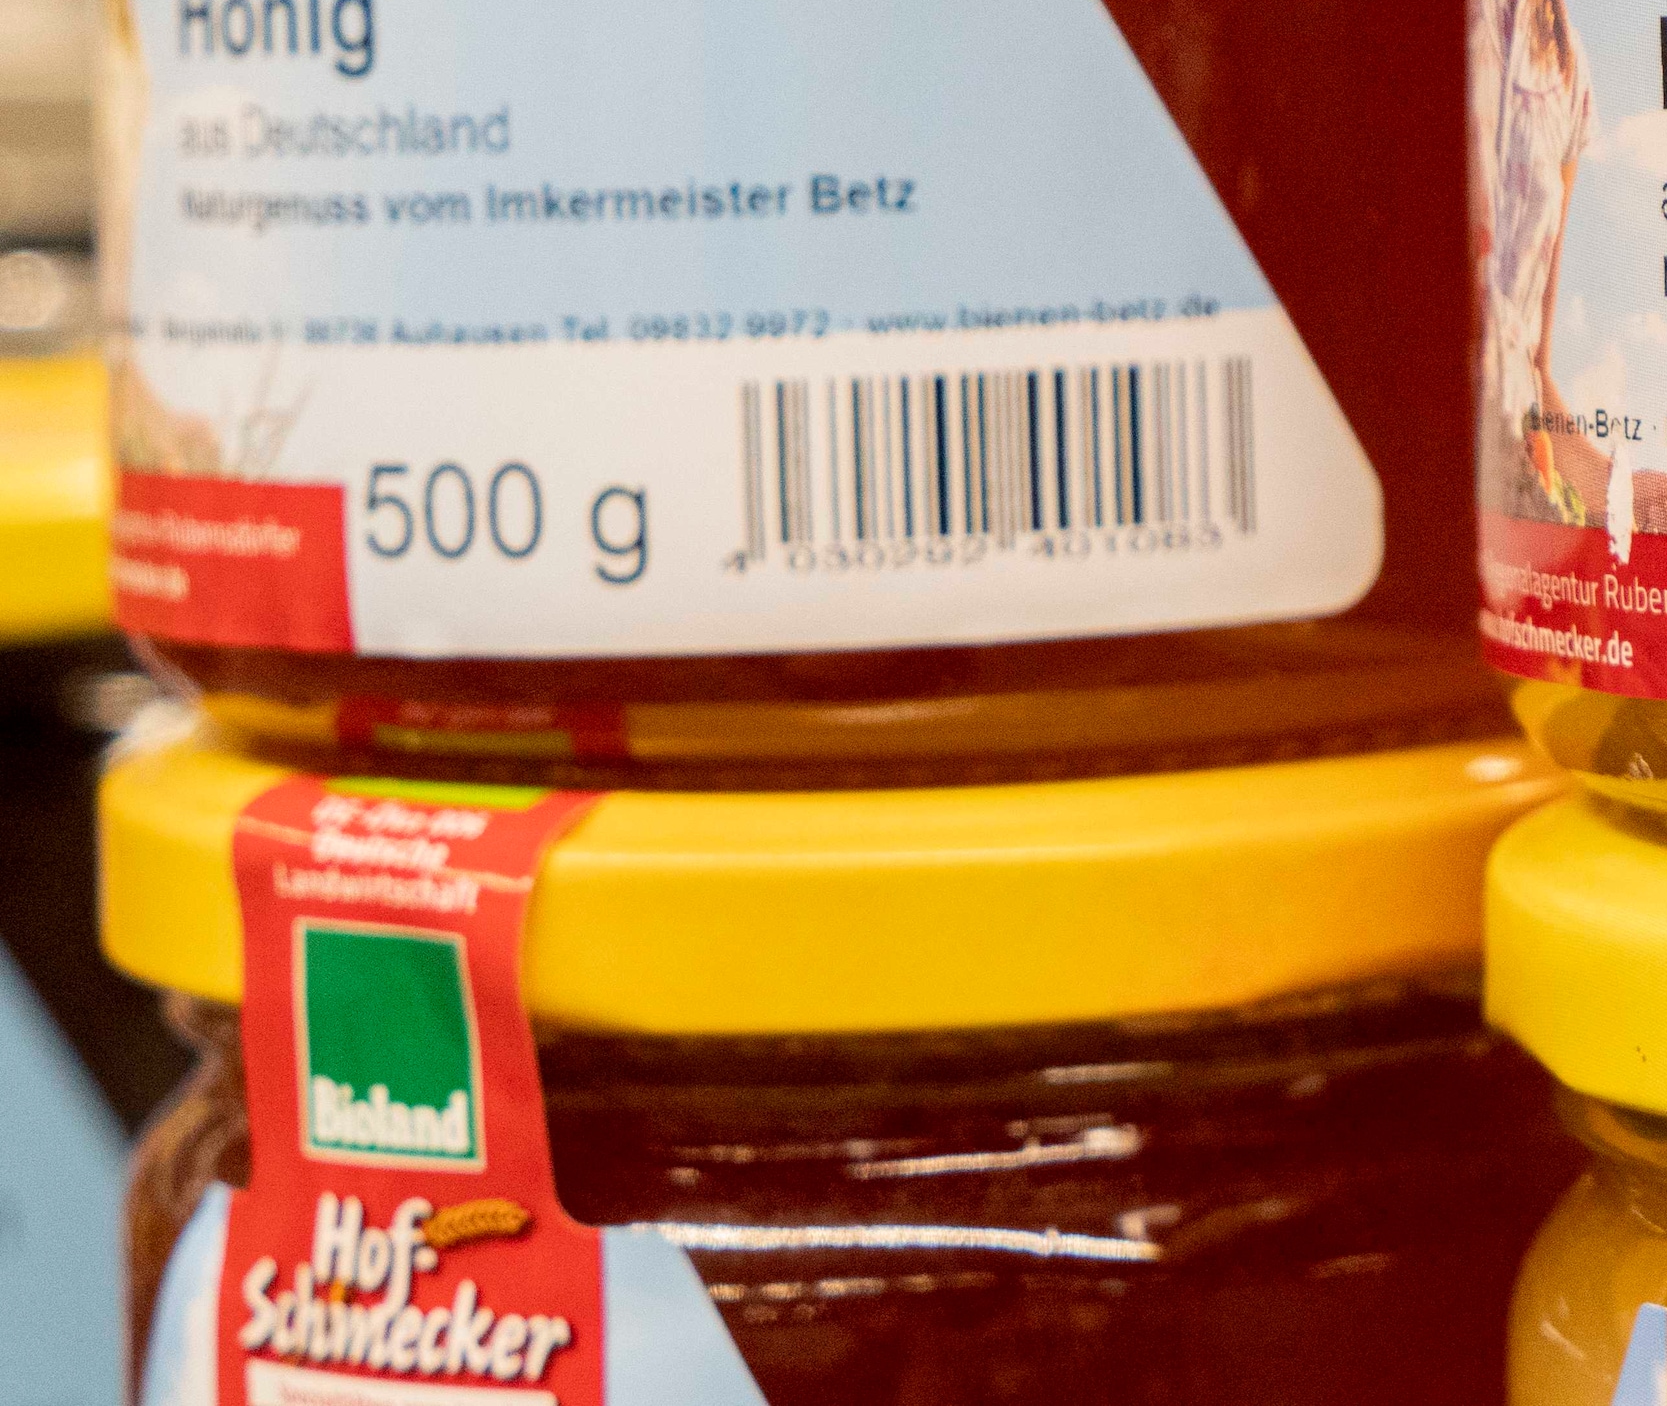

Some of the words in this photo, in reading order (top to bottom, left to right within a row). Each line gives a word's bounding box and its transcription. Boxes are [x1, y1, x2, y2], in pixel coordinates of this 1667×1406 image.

[241, 103, 511, 157] Deutschland
[179, 184, 369, 235] Naturgenuss
[381, 188, 471, 224] vom
[486, 176, 792, 224] Imkermeister
[808, 171, 919, 217] Betz
[366, 462, 543, 558] 500
[591, 484, 648, 586] g
[272, 859, 482, 915] Landwirtschaft
[311, 1075, 471, 1153] Bioland
[239, 1258, 572, 1383] Schmecker
